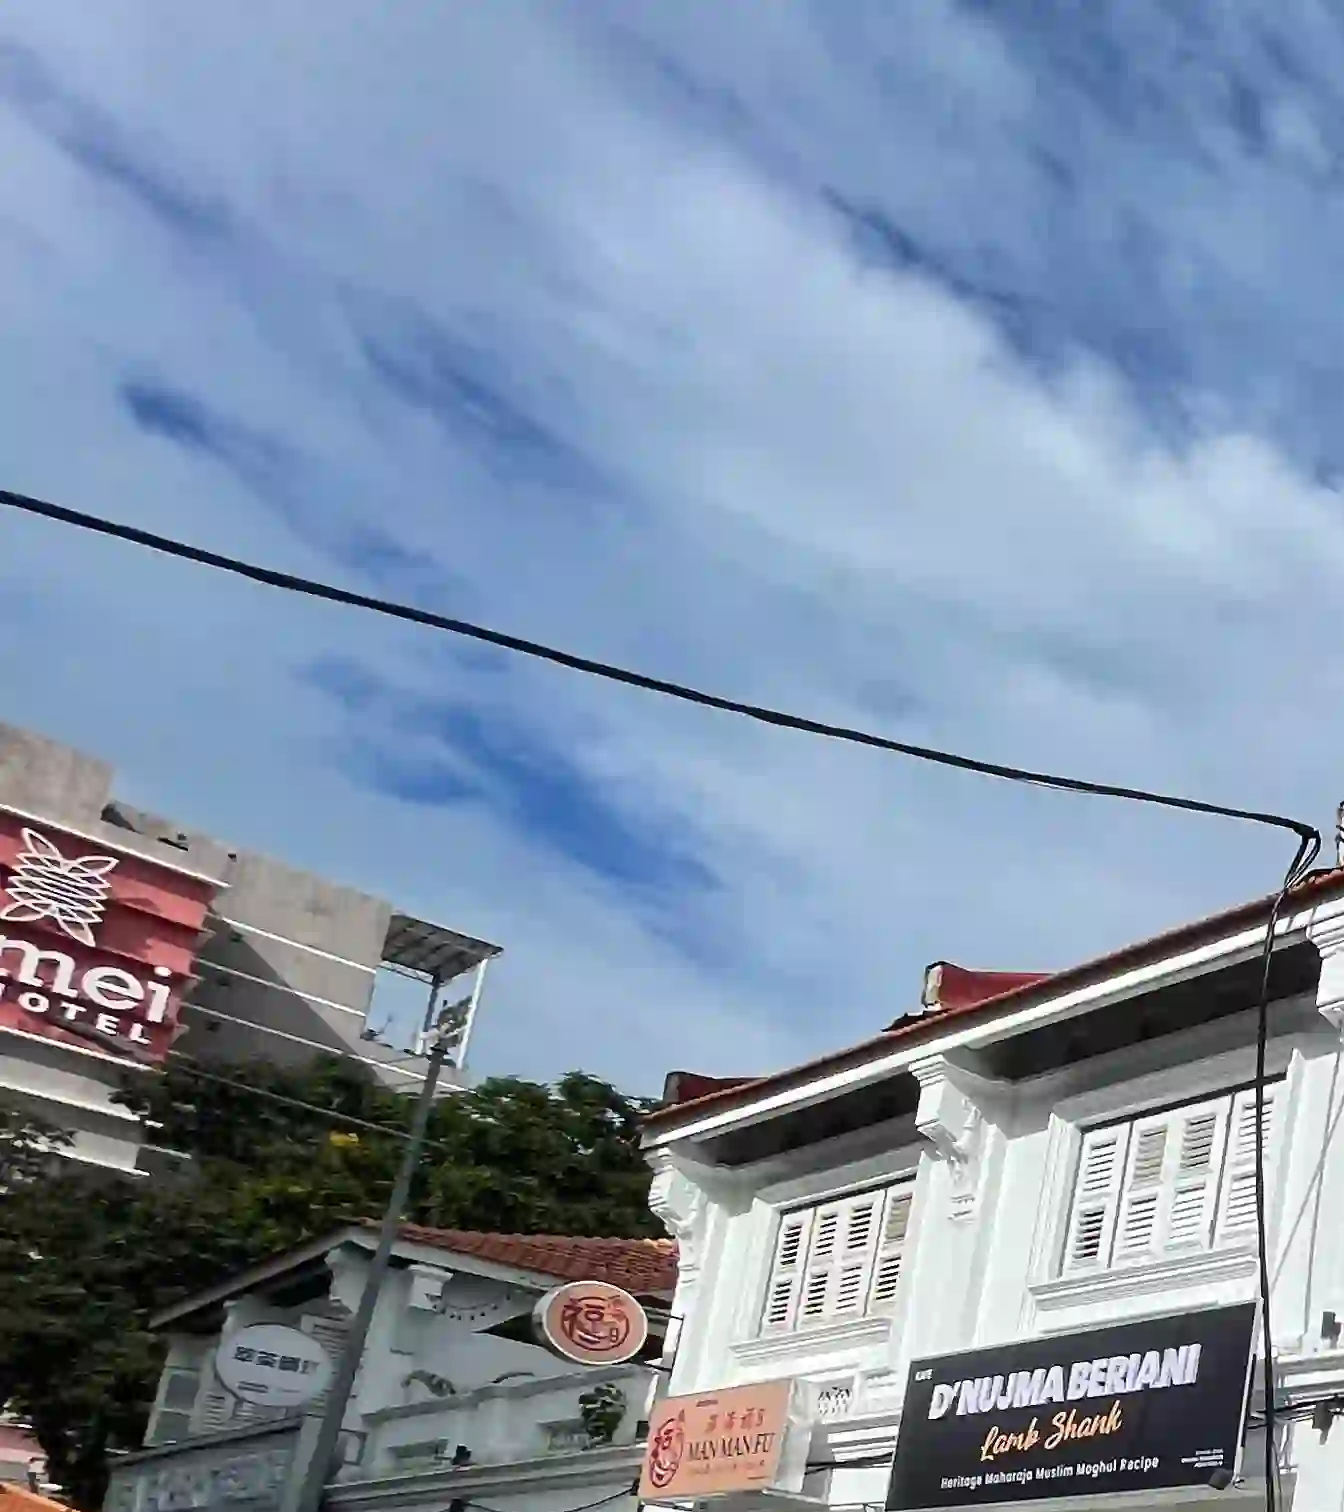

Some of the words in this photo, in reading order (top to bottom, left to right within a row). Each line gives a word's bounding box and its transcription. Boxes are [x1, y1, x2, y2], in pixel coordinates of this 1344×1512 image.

[928, 1364, 1064, 1420] D'NUJMA
[1067, 1343, 1202, 1401] BERIANI
[980, 1417, 1040, 1462] Lamb
[1044, 1400, 1124, 1450] Shank
[941, 1474, 982, 1490] Heritage
[985, 1469, 1033, 1485] Maharaja
[1035, 1465, 1073, 1480] Muslim
[1076, 1458, 1116, 1479] Moghul
[1120, 1455, 1160, 1473] Recipe
